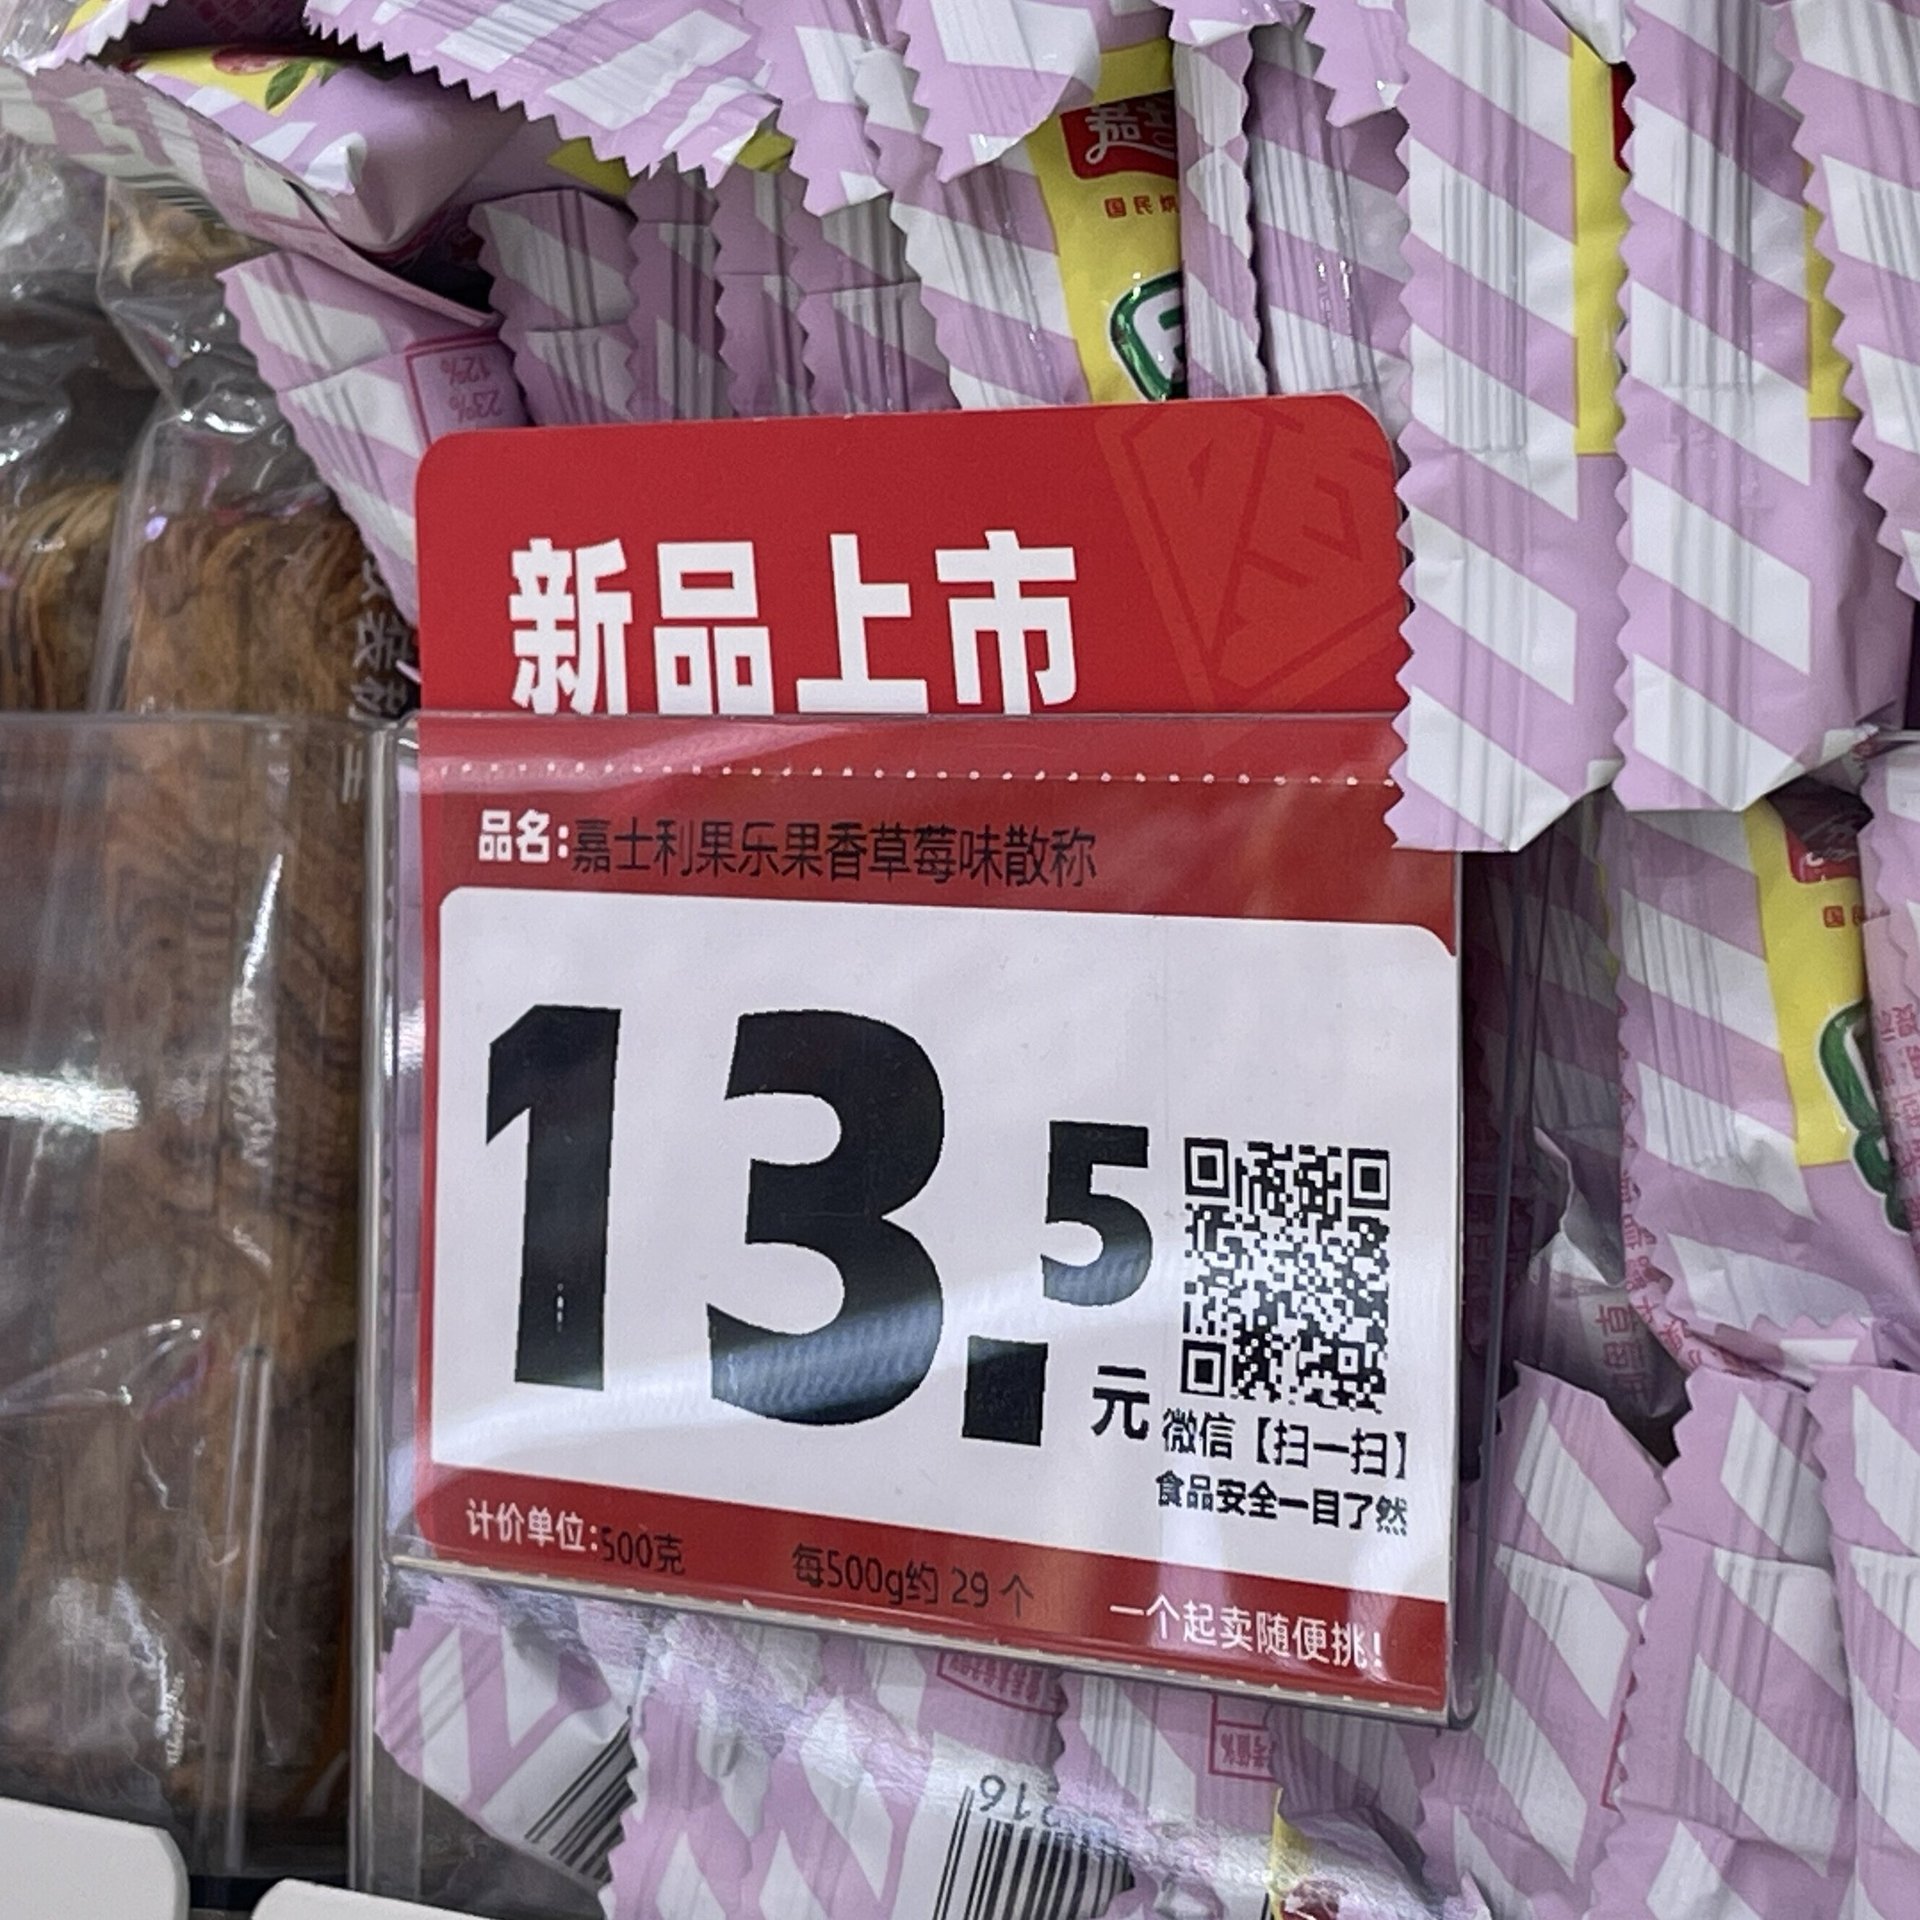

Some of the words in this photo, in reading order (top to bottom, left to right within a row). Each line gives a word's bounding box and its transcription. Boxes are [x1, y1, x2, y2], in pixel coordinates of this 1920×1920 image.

[440, 355, 491, 386] 12%
[449, 389, 504, 424] 23%
[510, 529, 1077, 716] 新品上市
[1090, 1364, 1151, 1441] 元
[1155, 1469, 1408, 1537] 食品安全一目了然
[599, 1526, 686, 1577] 500克
